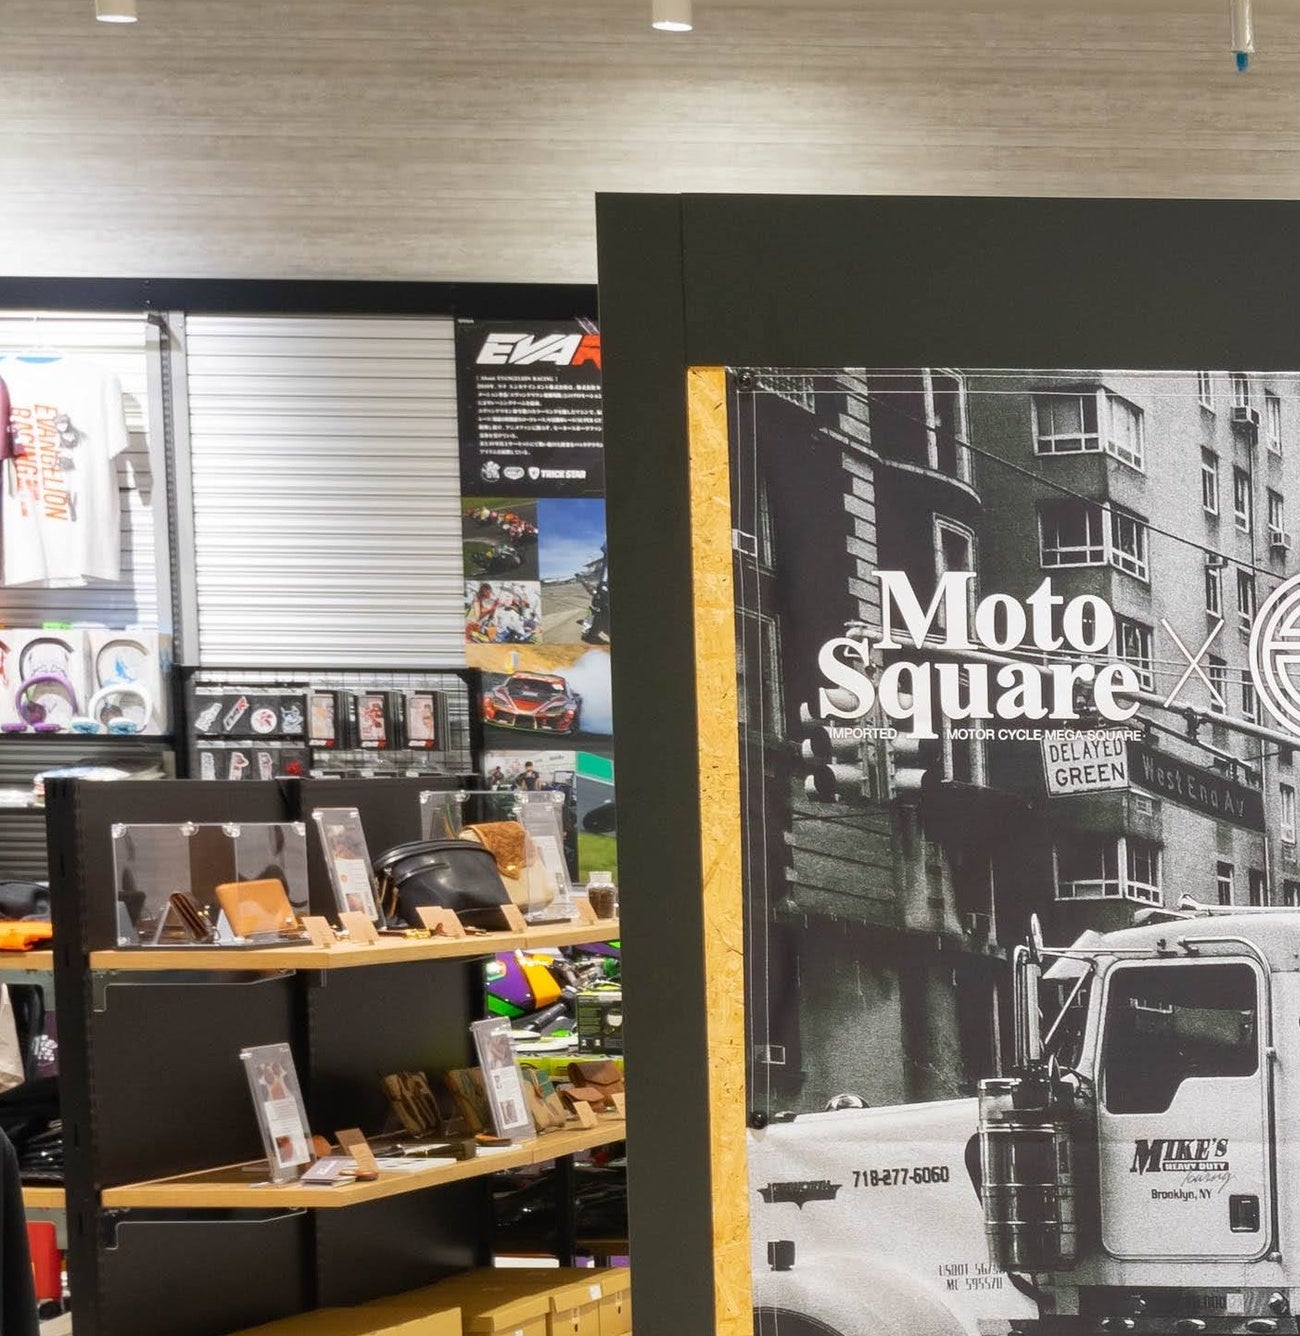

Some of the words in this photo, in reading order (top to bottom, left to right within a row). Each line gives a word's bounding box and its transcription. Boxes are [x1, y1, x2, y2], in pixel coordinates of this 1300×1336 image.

[34, 404, 69, 521] EVANGELION
[541, 470, 565, 479] TRICK
[566, 470, 587, 479] STAR
[872, 570, 1115, 651] Moto
[818, 637, 1140, 739] Square
[829, 729, 897, 740] IMPORTED
[946, 730, 995, 741] MOTOR
[998, 730, 1041, 741] CYCLE
[1044, 730, 1083, 741] MEGA
[1087, 730, 1142, 741] SQUARE
[1050, 739, 1123, 763] DELAYED
[1056, 762, 1125, 787] GREEN
[1130, 1138, 1229, 1176] MIKE'S
[1198, 1162, 1226, 1170] DUTY
[853, 1165, 950, 1188] 718-277-6060
[1151, 1188, 1198, 1201] Brooklyn,
[1199, 1188, 1213, 1199] NY
